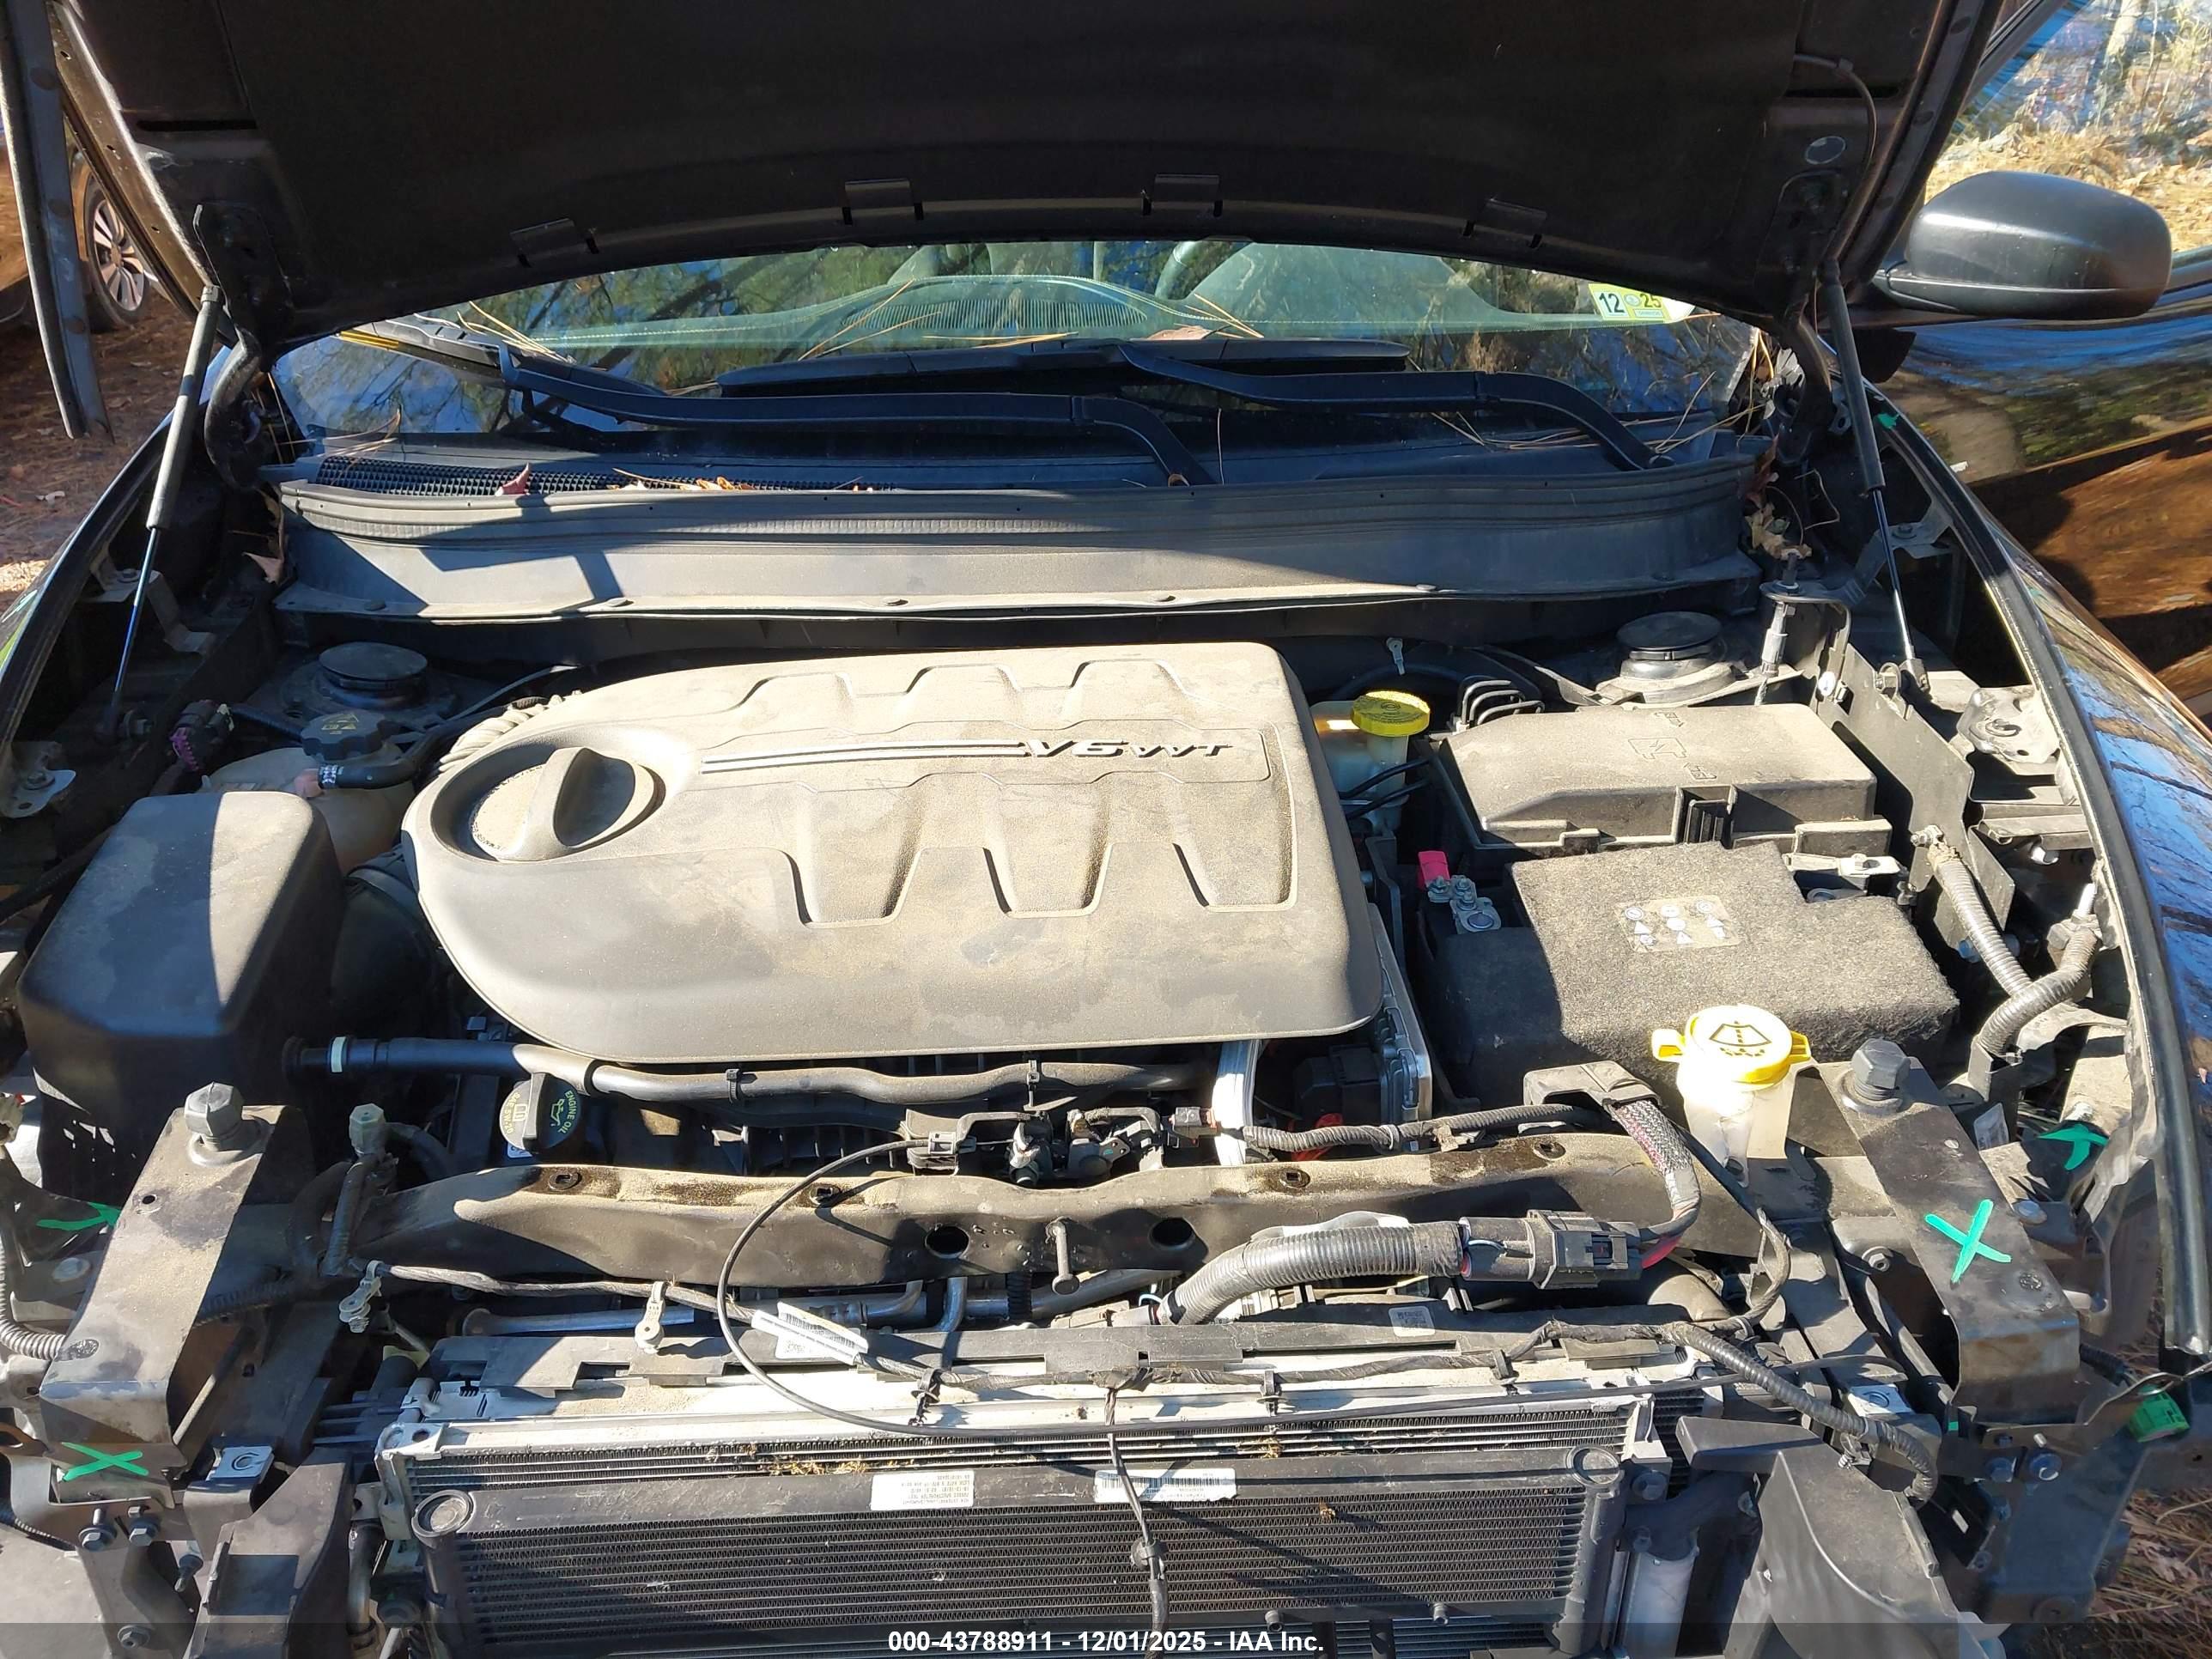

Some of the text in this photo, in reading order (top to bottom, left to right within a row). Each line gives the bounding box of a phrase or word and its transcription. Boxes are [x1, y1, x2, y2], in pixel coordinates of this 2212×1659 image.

[1599, 293, 1625, 313] 12
[1030, 738, 1129, 758] V6
[557, 1090, 577, 1134] ENGINE OIL
